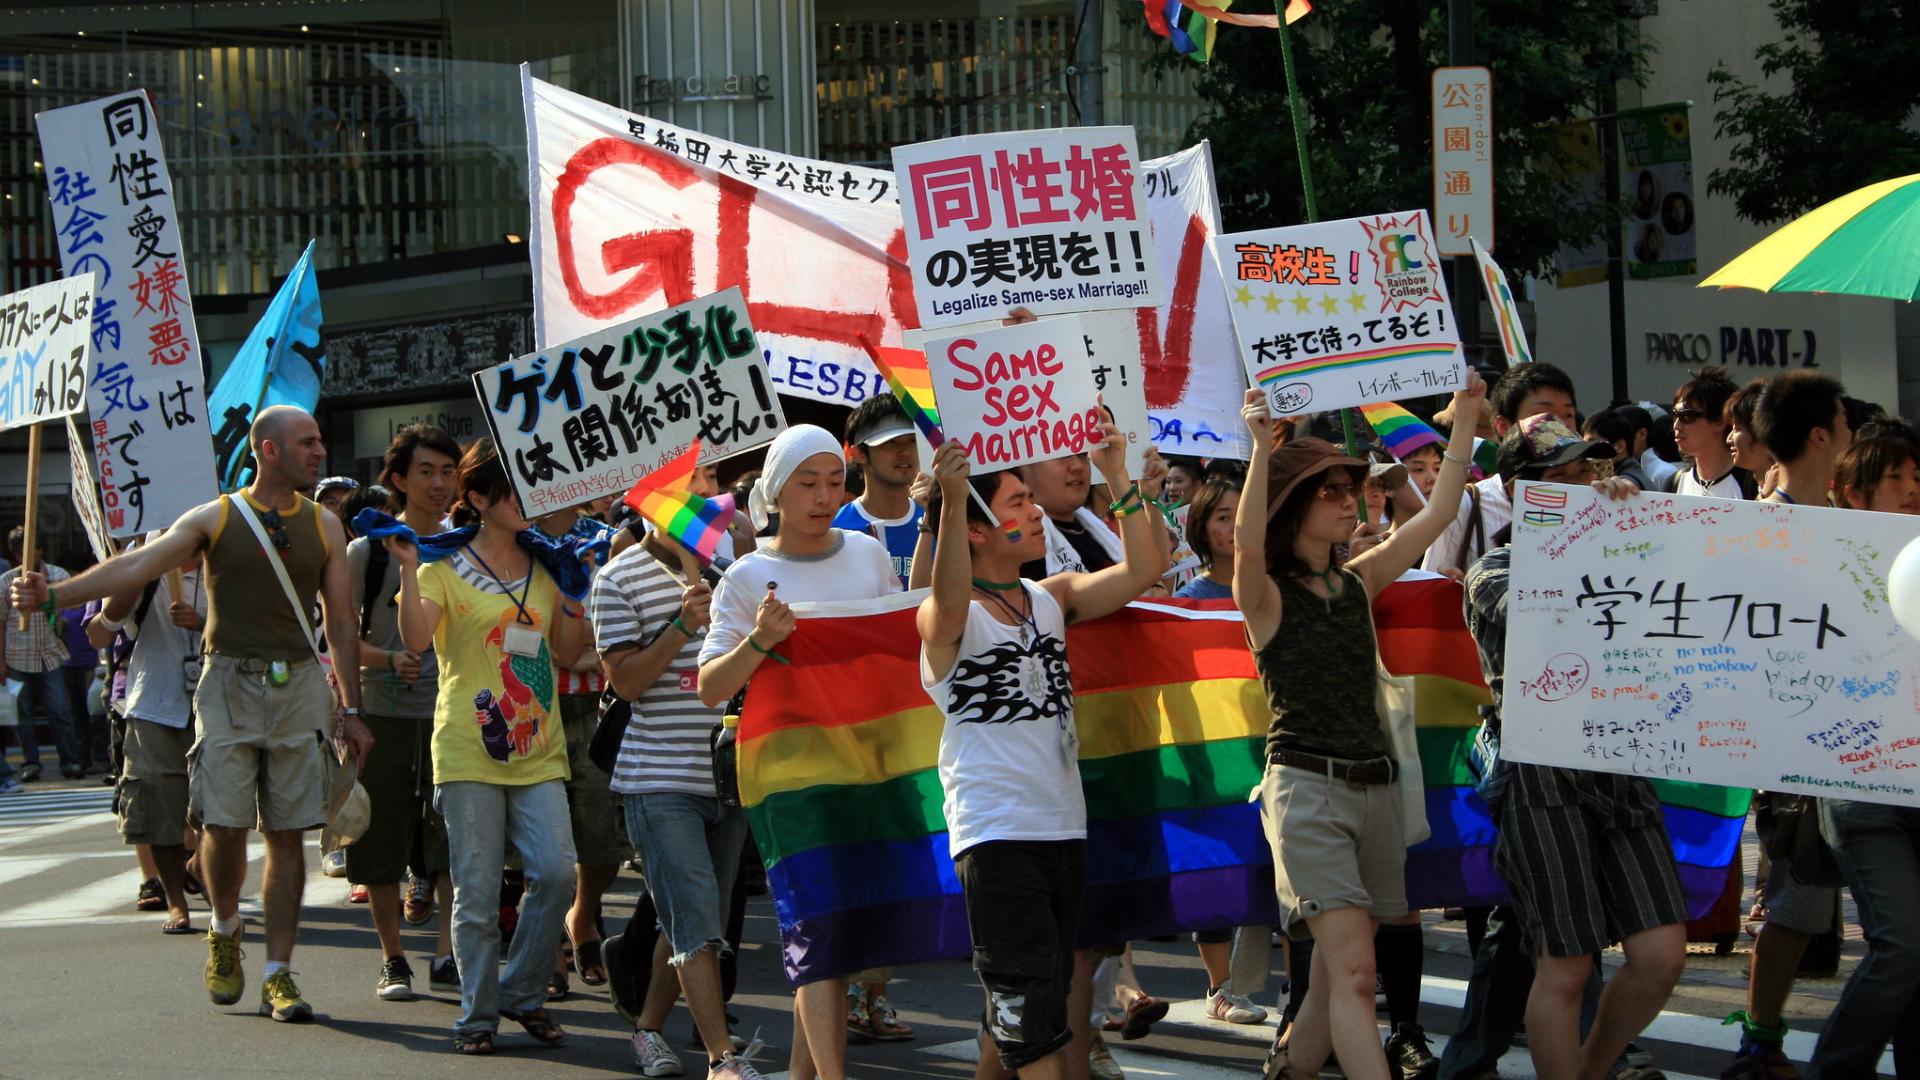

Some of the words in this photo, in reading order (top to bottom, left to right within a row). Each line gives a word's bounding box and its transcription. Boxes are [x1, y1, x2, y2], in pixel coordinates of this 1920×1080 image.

[1474, 83, 1489, 162] Koen-dori
[1442, 83, 1472, 239] 公園通り
[908, 143, 1138, 241] 同性婚
[102, 97, 196, 430] 同性愛嫌悪は
[925, 230, 1146, 288] の実現を!!
[1235, 242, 1361, 285] 高校生!
[932, 293, 998, 316] Legalize
[1001, 287, 1076, 307] Same-sex
[1078, 281, 1149, 301] Marriage!!
[1387, 275, 1427, 288] Rainbow
[1390, 286, 1429, 297] College
[1251, 309, 1446, 364] 大学で待ってるぞ!
[1645, 332, 1711, 363] PARCO
[1719, 326, 1820, 368] PART-2
[494, 304, 755, 433] ゲイと少子化
[982, 379, 1061, 428] sex
[437, 413, 473, 438] Store
[1603, 545, 1620, 558] be
[1624, 541, 1652, 555] free
[1576, 575, 1848, 649] 学生フロート
[1674, 664, 1695, 676] no
[1697, 659, 1758, 673] rainbow
[1677, 648, 1697, 660] no
[1701, 644, 1736, 657] rain
[1591, 687, 1607, 699] Be
[1613, 683, 1650, 700] proud!
